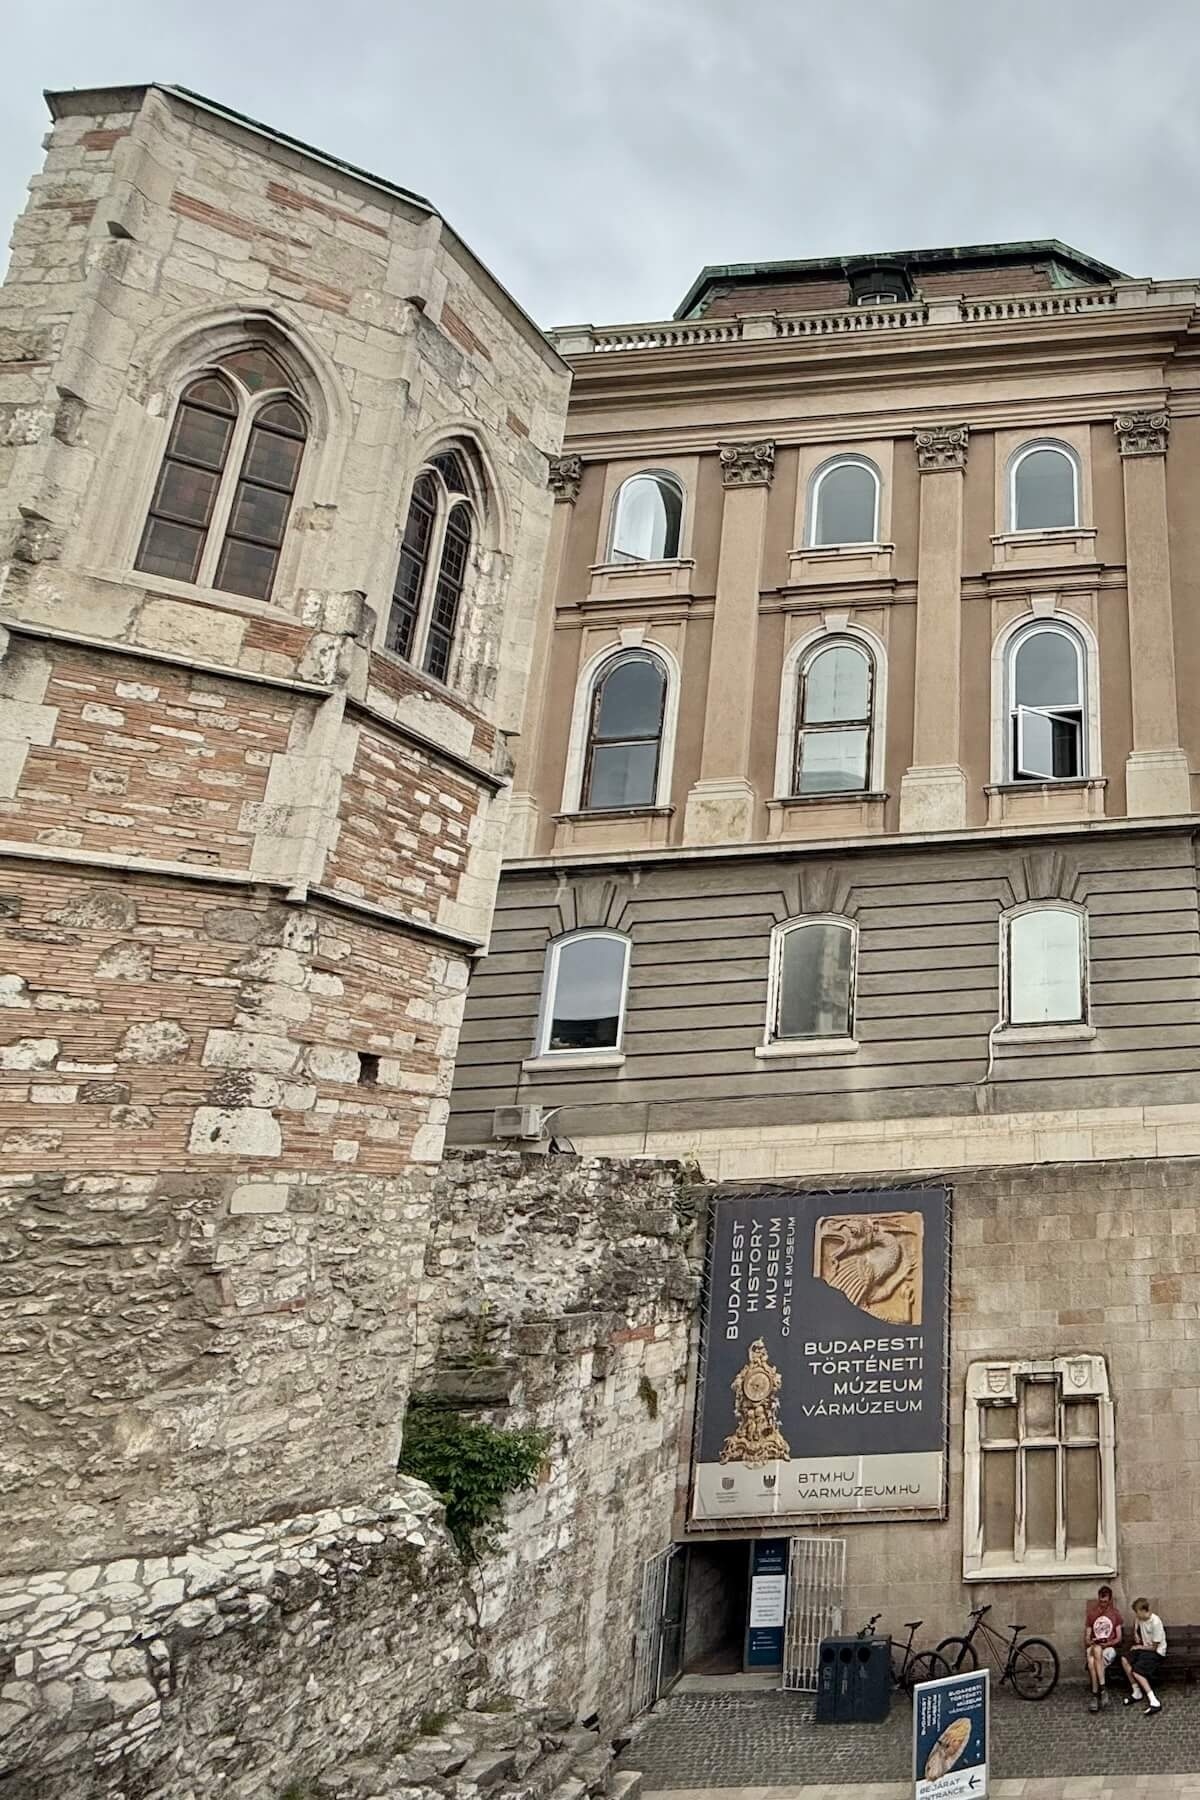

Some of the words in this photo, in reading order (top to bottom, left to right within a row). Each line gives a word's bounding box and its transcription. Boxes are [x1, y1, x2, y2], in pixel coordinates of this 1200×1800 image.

[747, 1219, 763, 1312] HISTORY
[765, 1217, 782, 1310] MUSEUM
[787, 1216, 797, 1276] MUSEUM
[726, 1220, 745, 1340] BUDAPEST
[782, 1278, 793, 1337] CASTLE
[804, 1336, 924, 1356] BUDAPESTI
[808, 1354, 924, 1375] TÖRTÉNETI
[833, 1375, 923, 1396] MÚZEUM
[802, 1397, 923, 1417] VÁRMÚZEUM
[798, 1471, 855, 1484] BTM.HU
